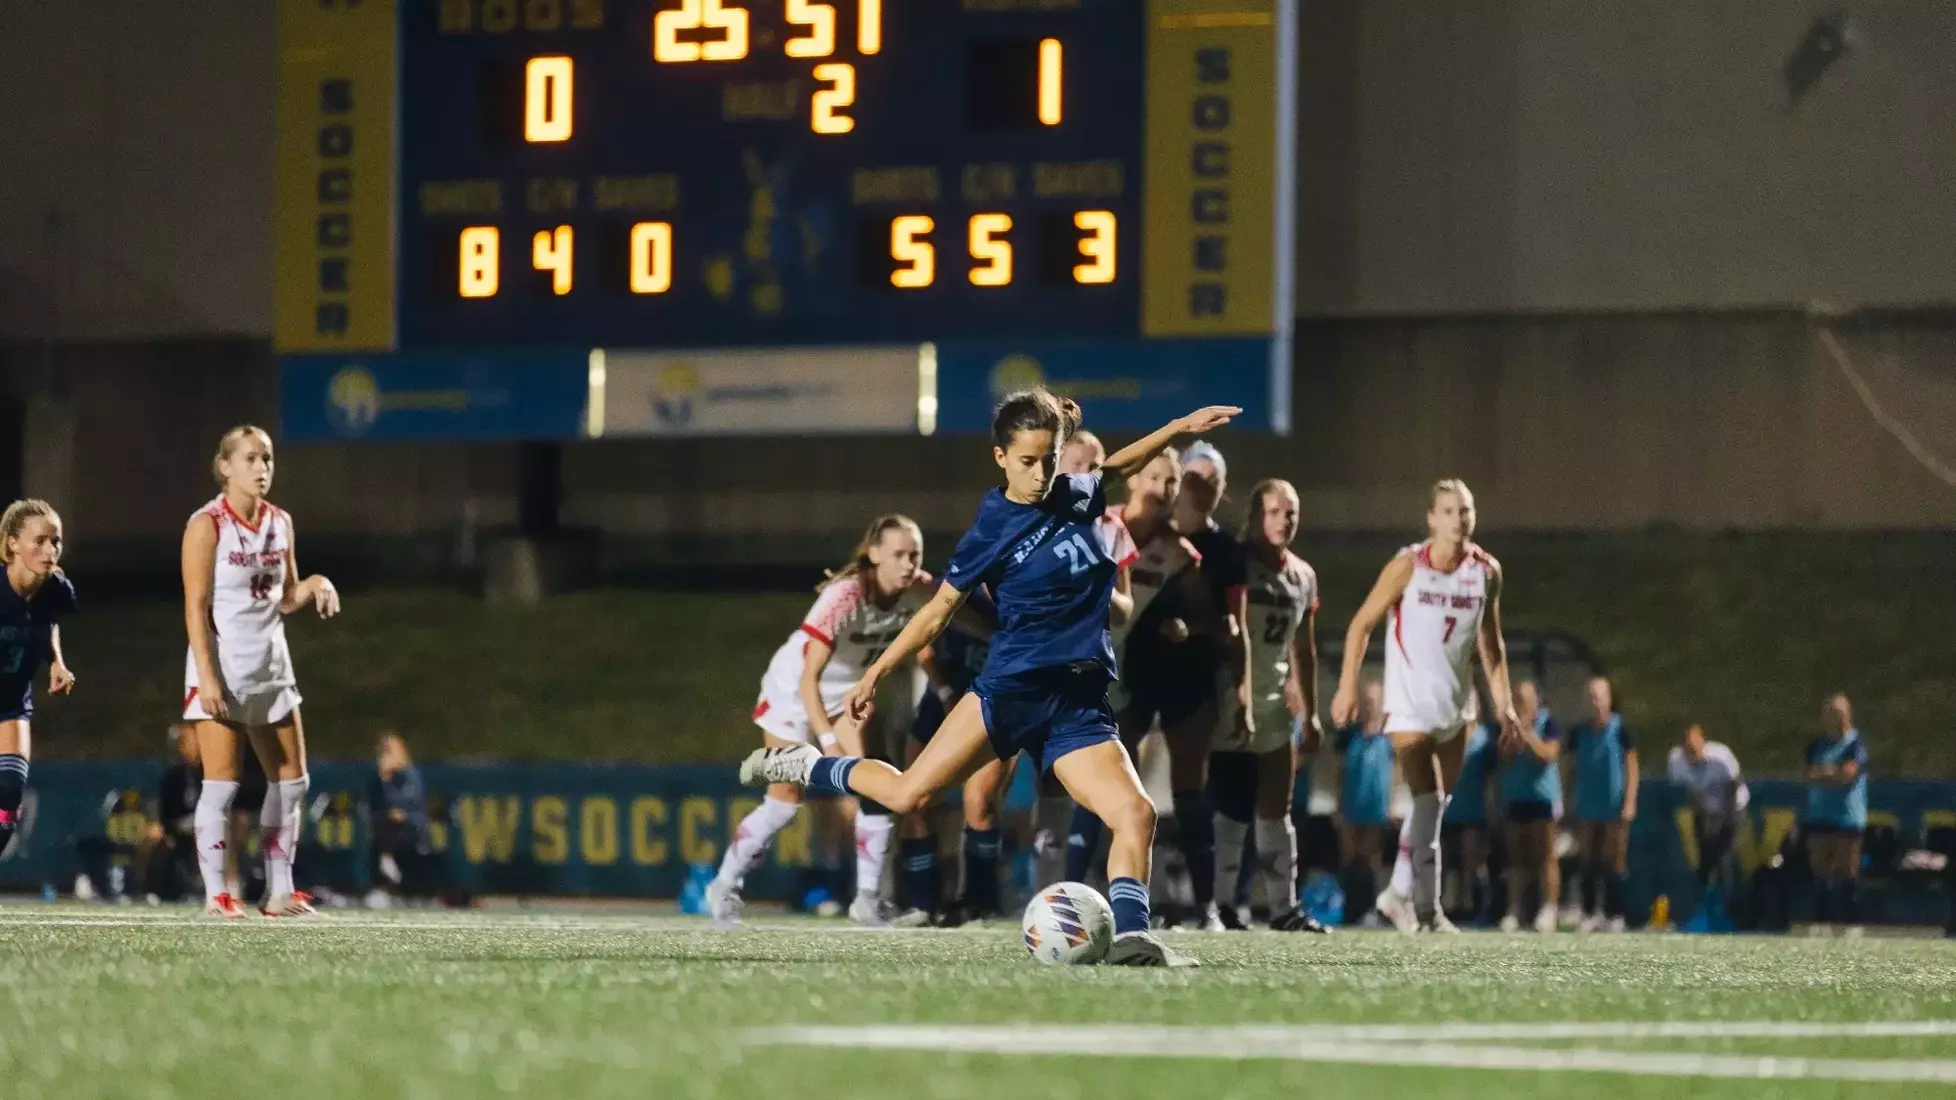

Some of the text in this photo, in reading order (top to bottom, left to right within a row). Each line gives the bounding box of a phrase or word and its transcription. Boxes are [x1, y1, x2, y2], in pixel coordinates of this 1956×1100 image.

[525, 56, 573, 142] 0
[812, 63, 855, 134] 2
[1038, 38, 1062, 125] 1
[459, 222, 672, 298] 8 4 0
[890, 210, 1116, 288] 5 5 3
[1053, 533, 1099, 575] 21
[1443, 615, 1457, 643] 7
